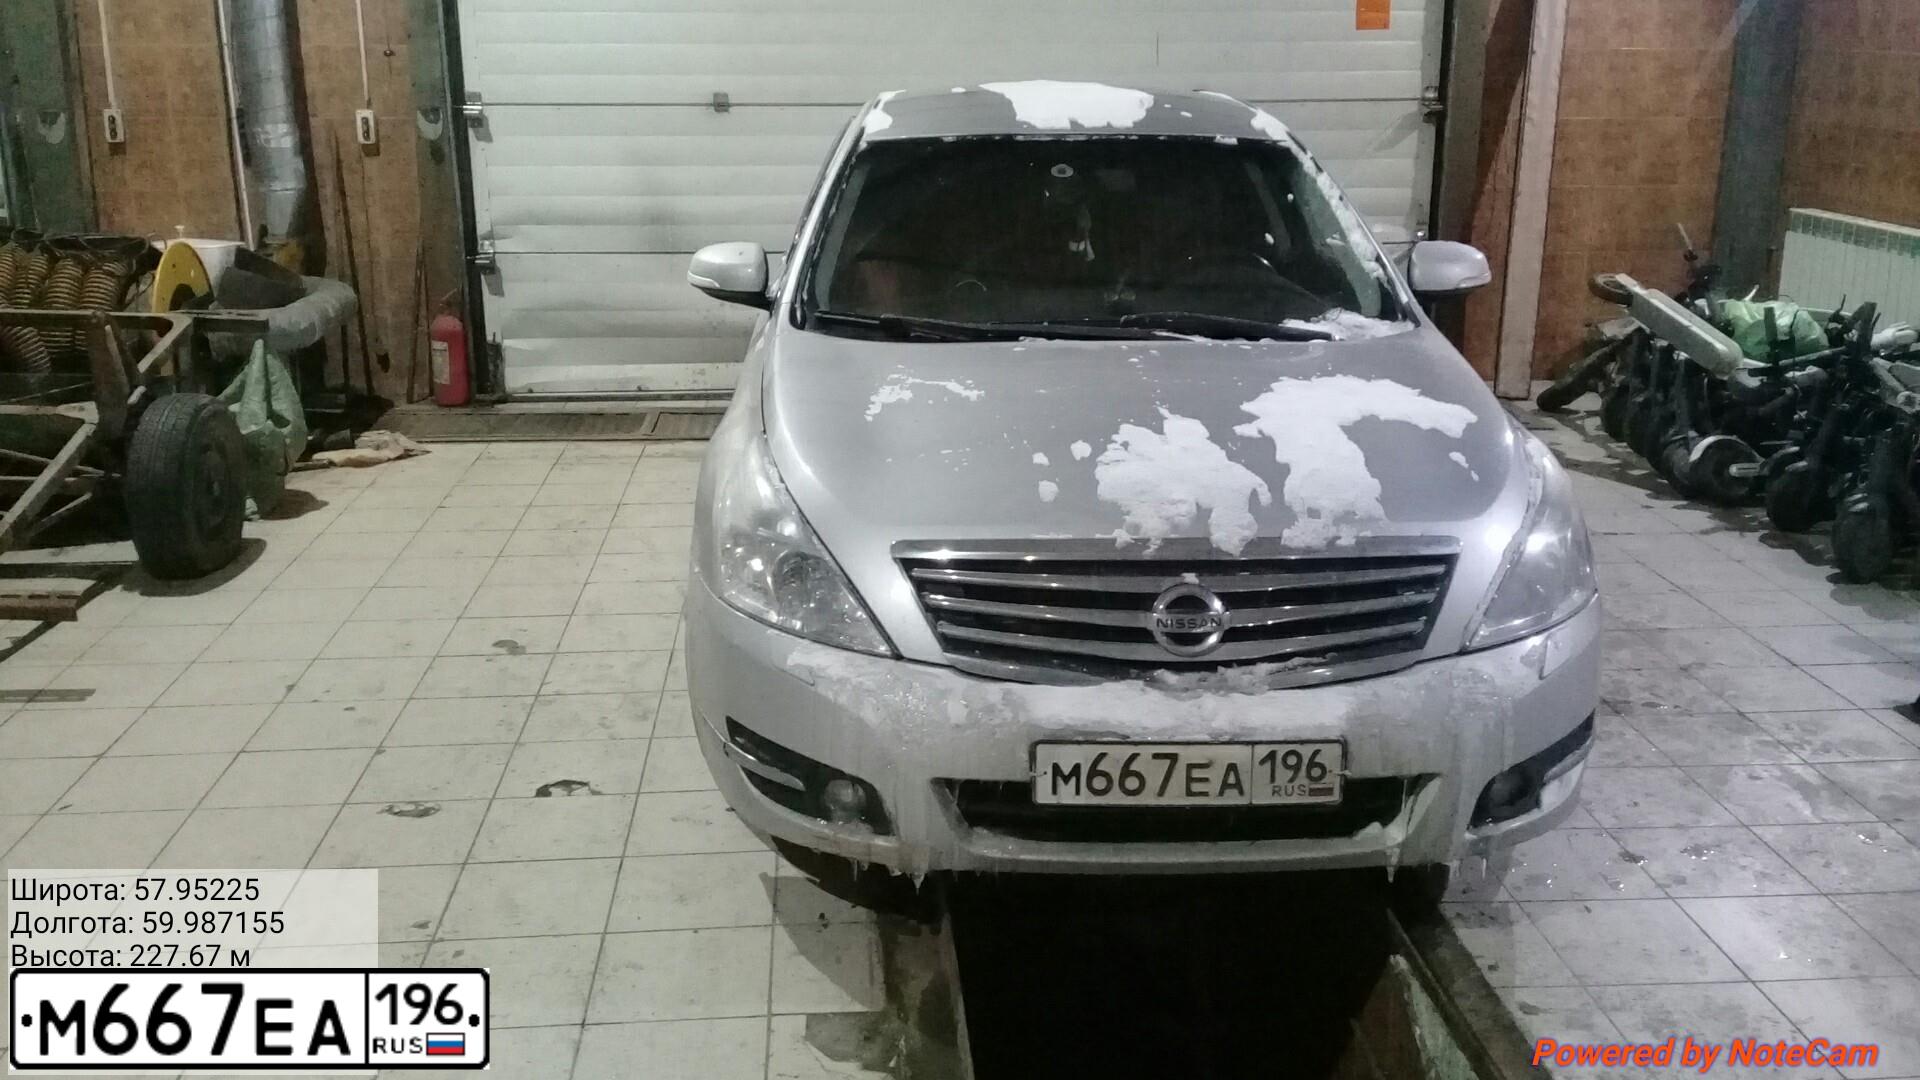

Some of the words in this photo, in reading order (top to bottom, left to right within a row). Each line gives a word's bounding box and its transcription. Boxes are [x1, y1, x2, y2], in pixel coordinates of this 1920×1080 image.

[1156, 616, 1222, 629] NISSAN
[1258, 748, 1328, 784] 196
[1271, 783, 1307, 797] RUS
